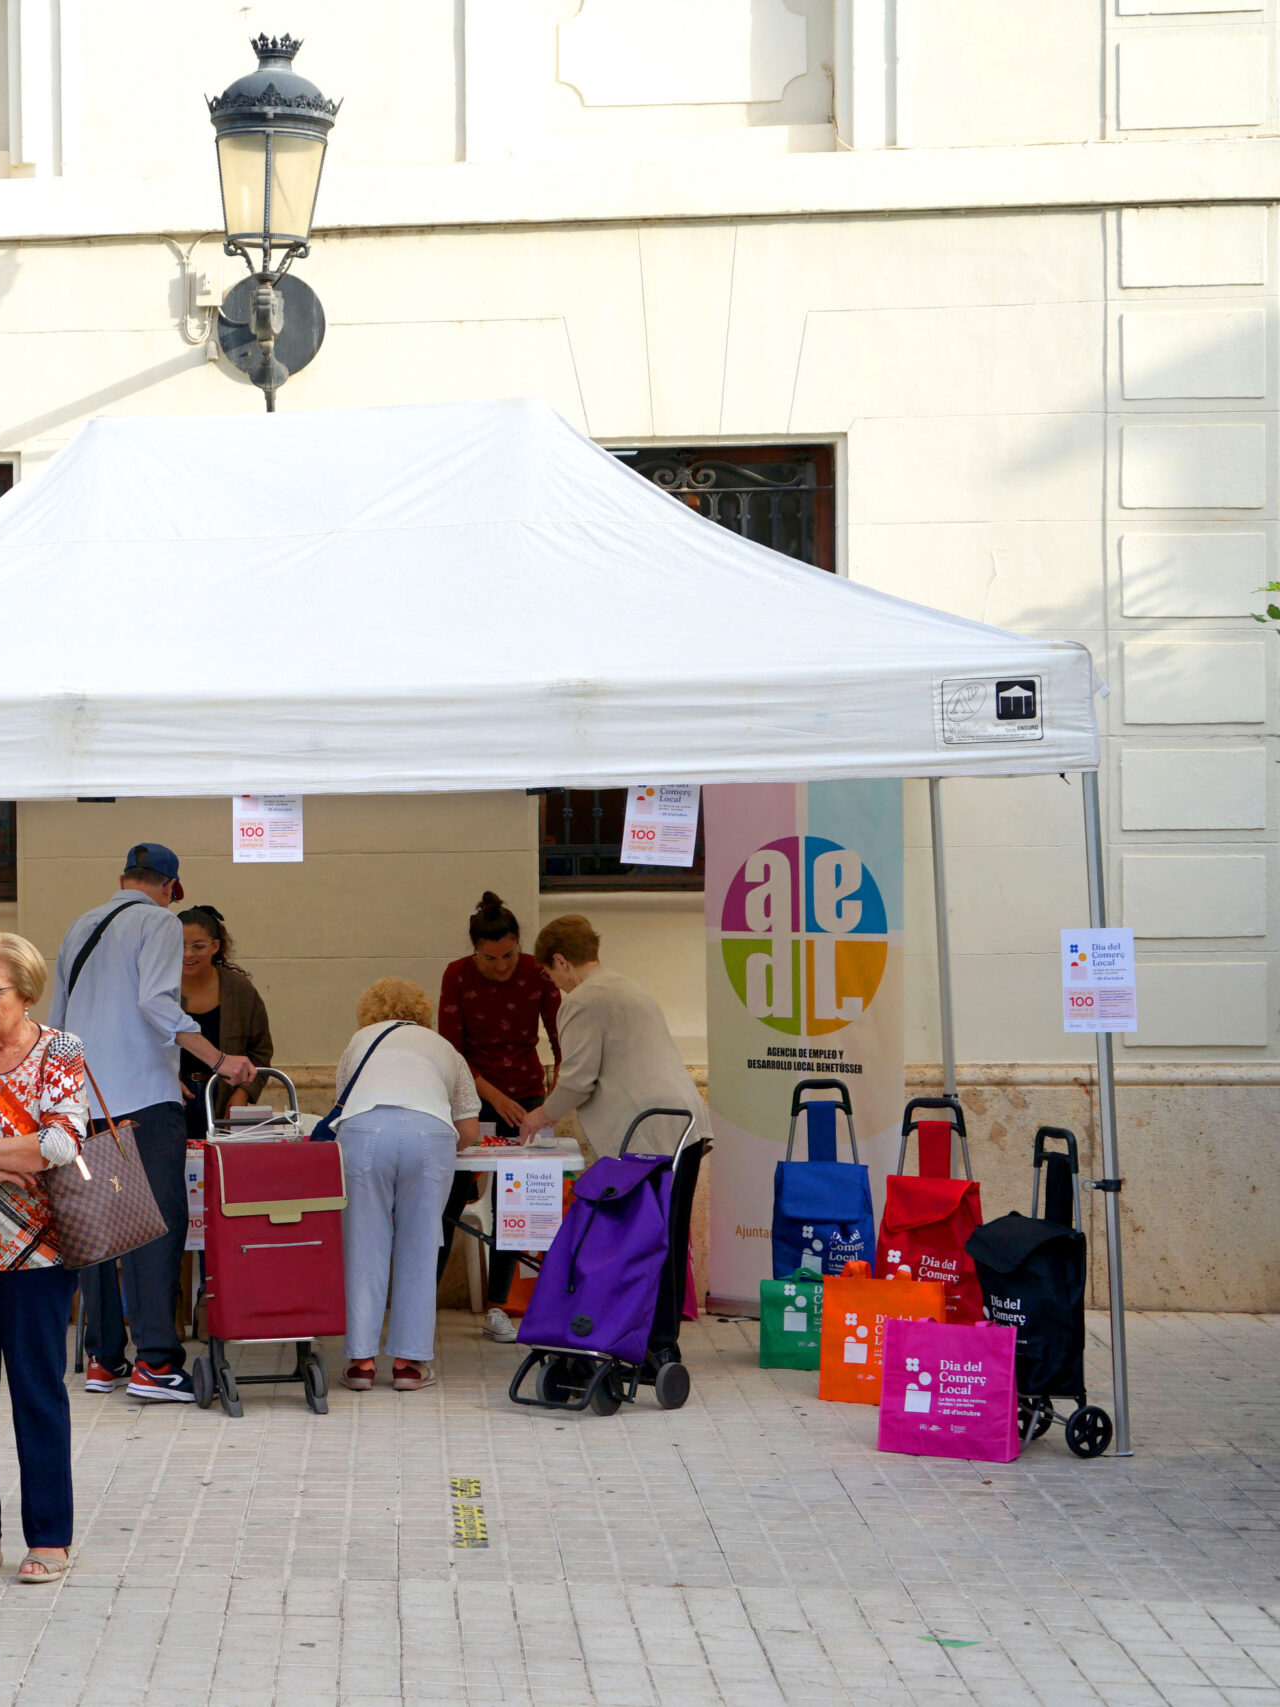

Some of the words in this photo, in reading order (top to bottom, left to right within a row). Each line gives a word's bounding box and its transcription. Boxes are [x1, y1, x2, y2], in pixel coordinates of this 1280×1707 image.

[660, 787, 692, 798] Comerç
[660, 795, 682, 803] Local
[239, 827, 264, 837] 100
[631, 830, 655, 840] 100
[1108, 942, 1120, 950] del
[1093, 959, 1115, 967] Local
[1070, 996, 1094, 1007] 100
[767, 1046, 797, 1058] AGENCIA
[799, 1048, 808, 1058] DE
[809, 1048, 837, 1060] EMPLEO
[838, 1050, 844, 1060] Y
[747, 1059, 792, 1071] DESARROLLO
[794, 1061, 815, 1072] LOCAL
[816, 1062, 863, 1074] BENETÚSSER
[189, 1219, 203, 1228] 10
[502, 1219, 525, 1229] 100
[829, 1241, 865, 1251] Comerç
[829, 1251, 858, 1262] Local
[921, 1255, 940, 1268] Dia
[941, 1259, 957, 1271] del
[919, 1266, 960, 1284] Comerç
[990, 1295, 1003, 1309] Dia
[1003, 1298, 1021, 1310] del
[992, 1307, 1026, 1326] Comerç
[940, 1360, 961, 1371] Dia
[963, 1361, 982, 1372] del
[939, 1371, 987, 1386] Comerç
[939, 1383, 972, 1395] Local
